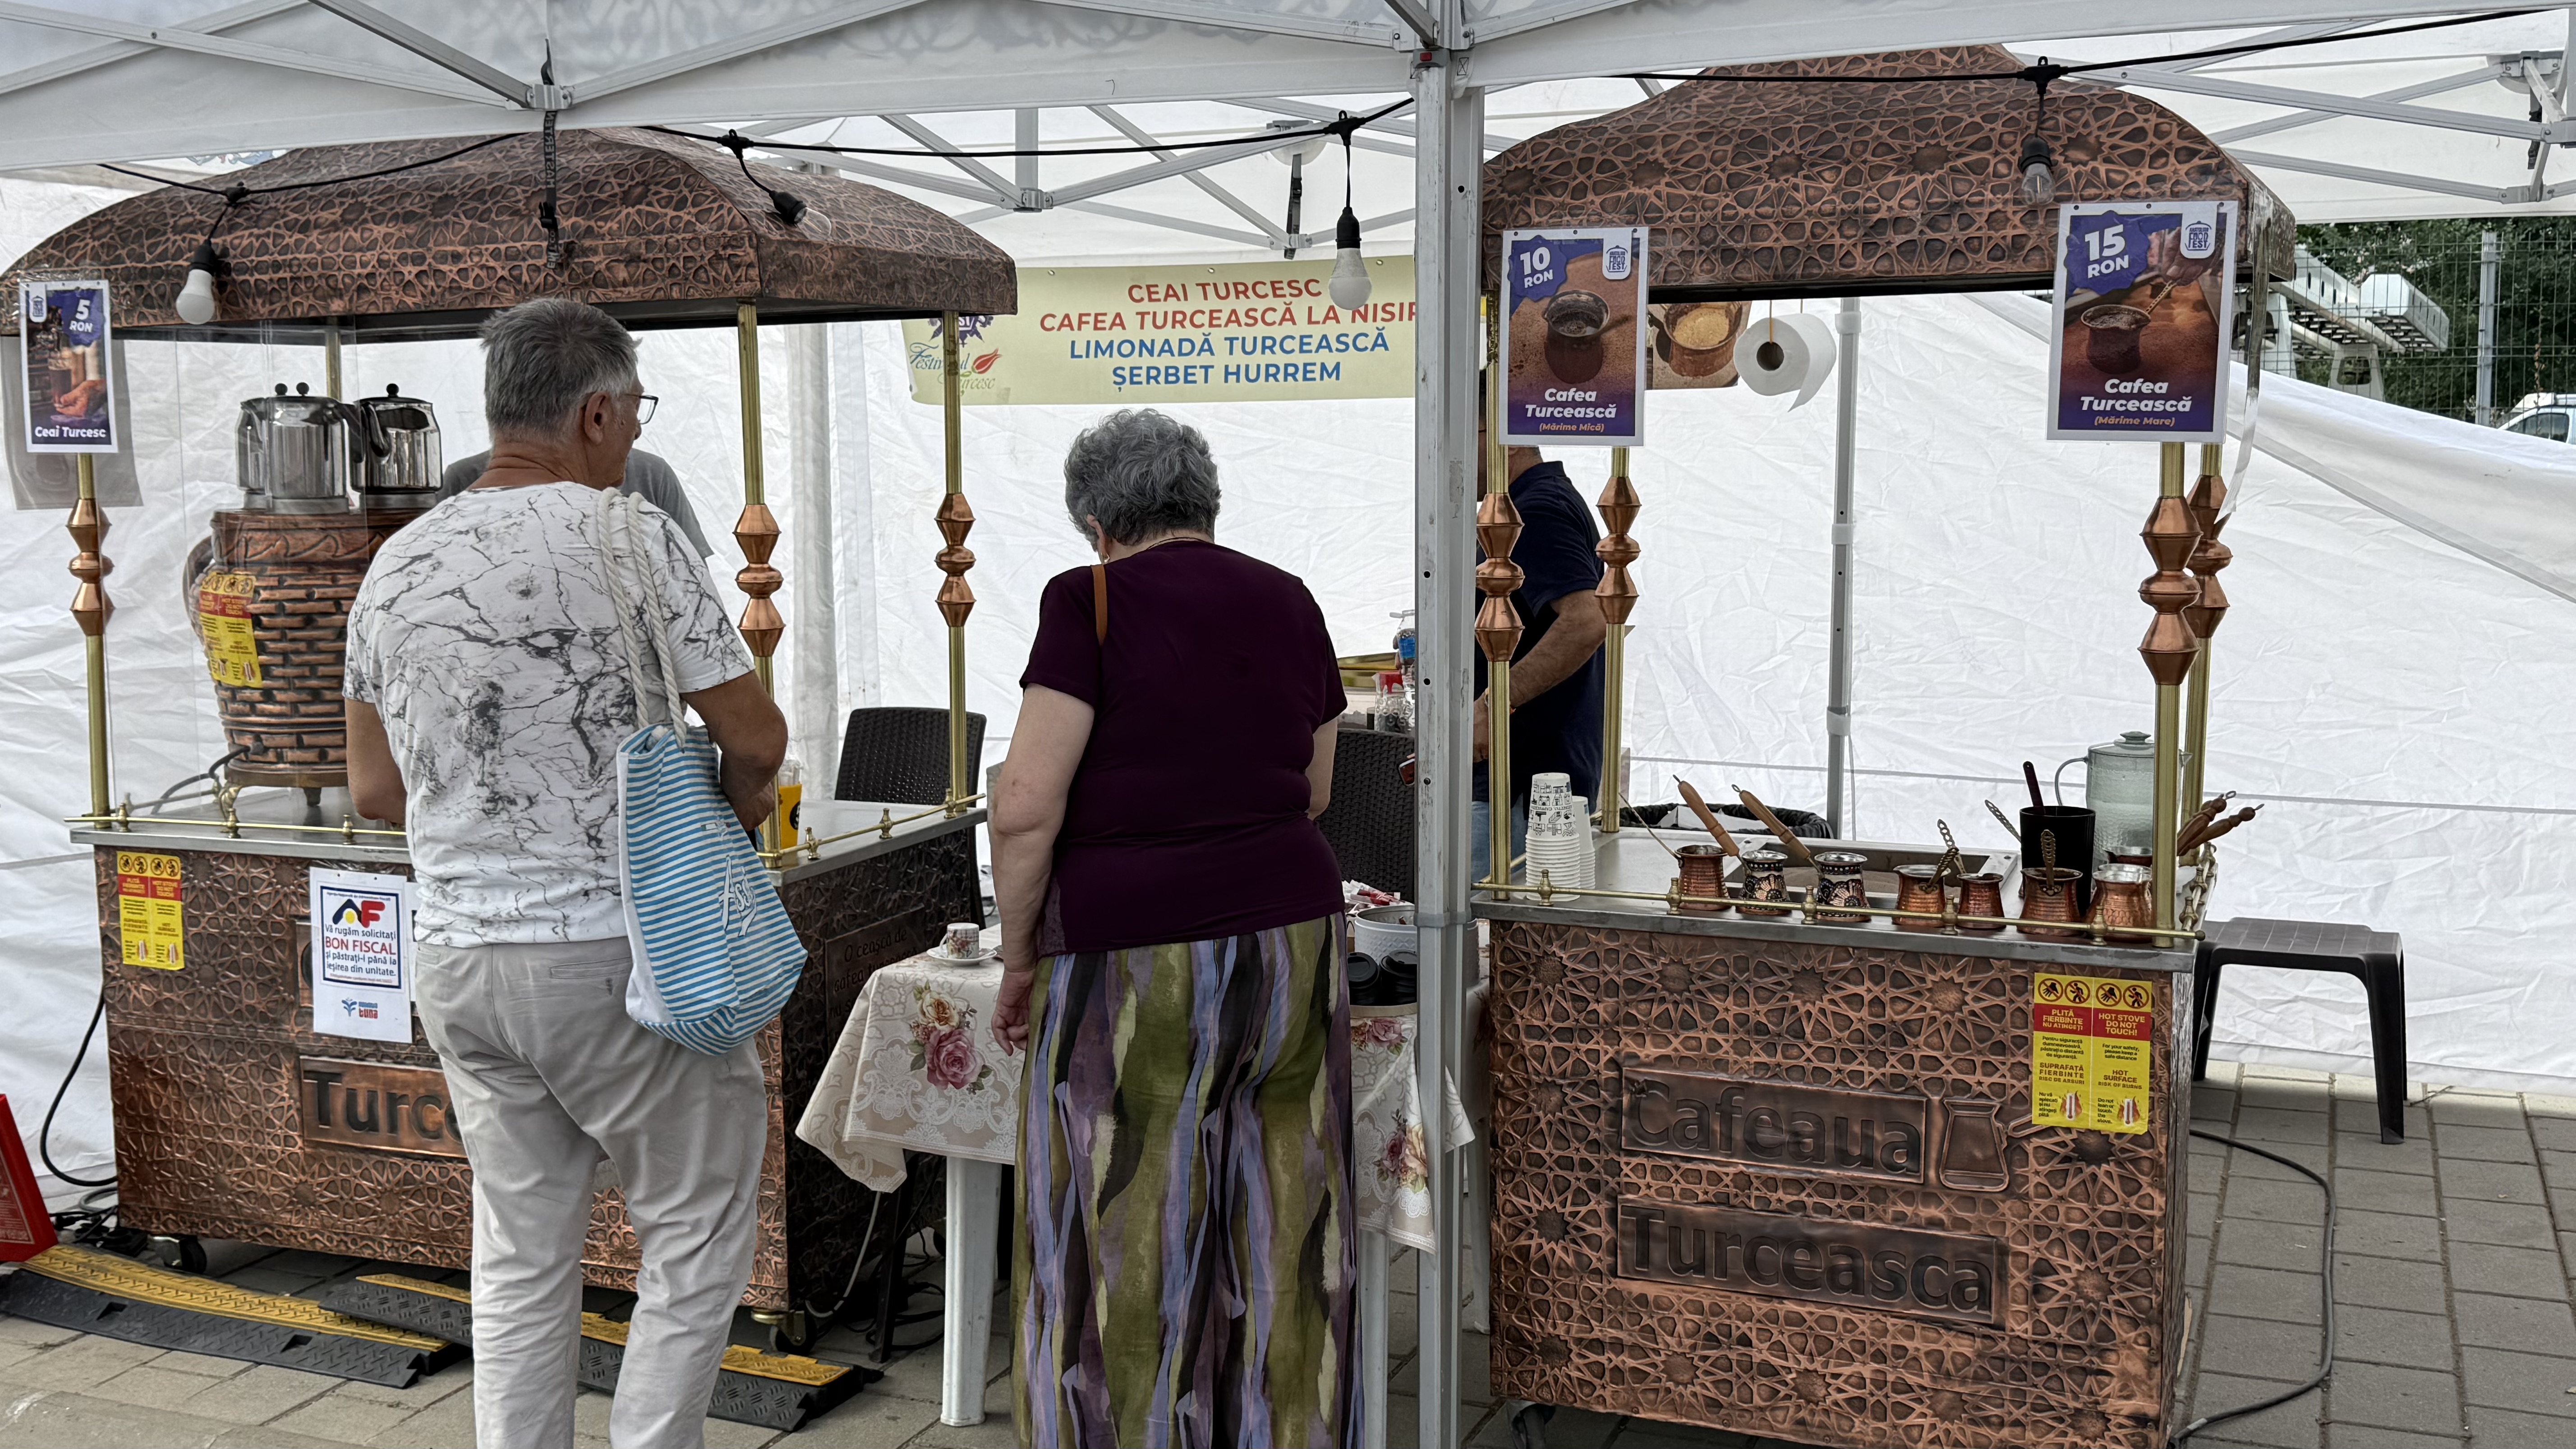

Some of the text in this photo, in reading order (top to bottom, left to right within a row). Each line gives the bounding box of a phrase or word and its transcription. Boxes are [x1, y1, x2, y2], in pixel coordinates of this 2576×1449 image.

[2085, 224, 2125, 261] 15
[1520, 247, 1550, 275] 10
[2088, 255, 2129, 279] RON
[1524, 269, 1553, 288] RON
[1128, 279, 1322, 303] CEAI TURCESC
[76, 299, 90, 320] 5
[1040, 312, 1127, 331] CAFEA
[1136, 301, 1297, 330] TURCEASCĂ
[1307, 305, 1341, 325] LA
[69, 320, 93, 332] RON
[1070, 327, 1389, 359] LIMONADĂ TURCEASCĂ
[1113, 362, 1341, 392] ȘERBET HURREM
[2105, 378, 2168, 394] Cafea
[1545, 388, 1597, 401] Cafea
[1525, 404, 1617, 418] Turcească
[2080, 396, 2192, 412] Turcească
[1539, 423, 1605, 432] (Mărime Mică)
[2094, 416, 2175, 427] (Mărime Mare)
[35, 425, 106, 437] Ceai Turcesc
[325, 924, 333, 933] Vă
[335, 927, 359, 936] rugăm
[325, 936, 396, 955] BON FISCAL
[844, 944, 853, 962] O
[894, 928, 907, 943] de
[351, 965, 363, 973] din
[390, 957, 396, 965] la
[834, 970, 864, 993] cafea
[2043, 1015, 2083, 1024] FIERBINTE
[2105, 1027, 2137, 1035] TOUCH!
[2039, 1069, 2084, 1078] FIERBINTE
[2103, 1075, 2137, 1083] SURFACE
[1633, 1080, 1921, 1173] Cafeaua
[1621, 1205, 1993, 1313] Turceasca
